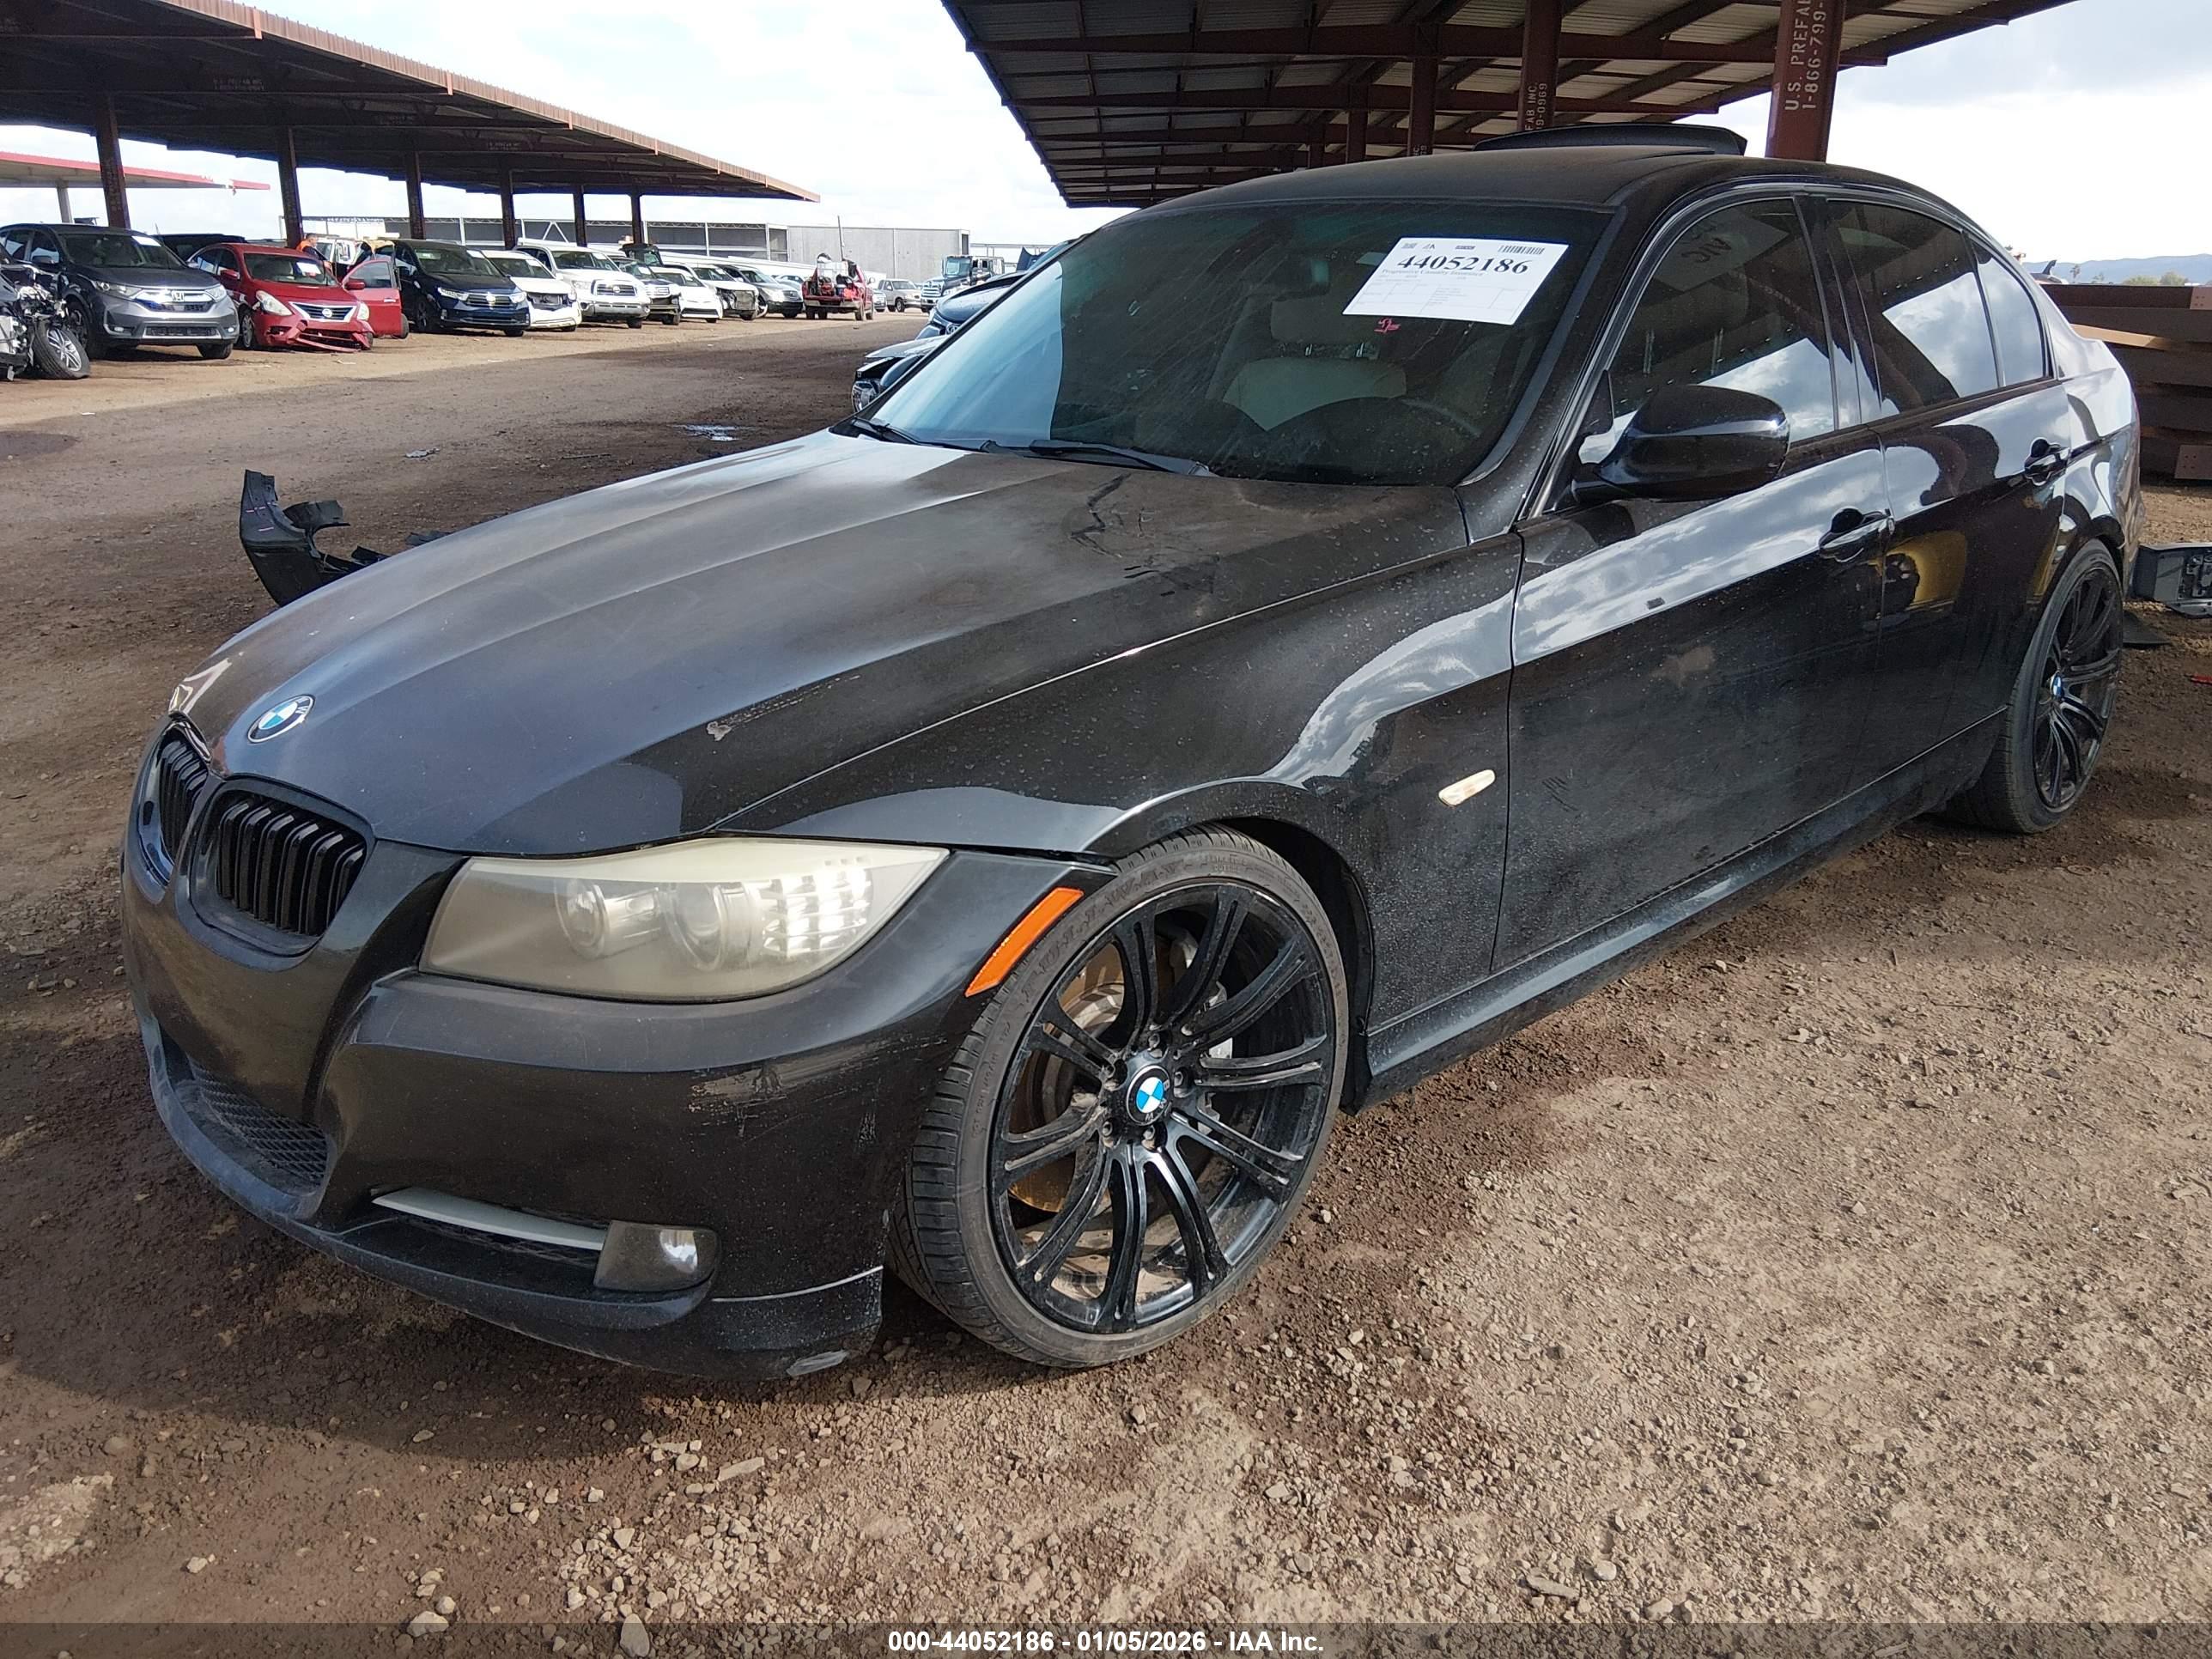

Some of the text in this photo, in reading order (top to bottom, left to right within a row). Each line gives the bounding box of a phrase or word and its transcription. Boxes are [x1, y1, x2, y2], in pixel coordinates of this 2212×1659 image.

[1784, 76, 1804, 111] U.S.
[1397, 255, 1533, 274] 44052186
[1145, 1079, 1170, 1122] BMW
